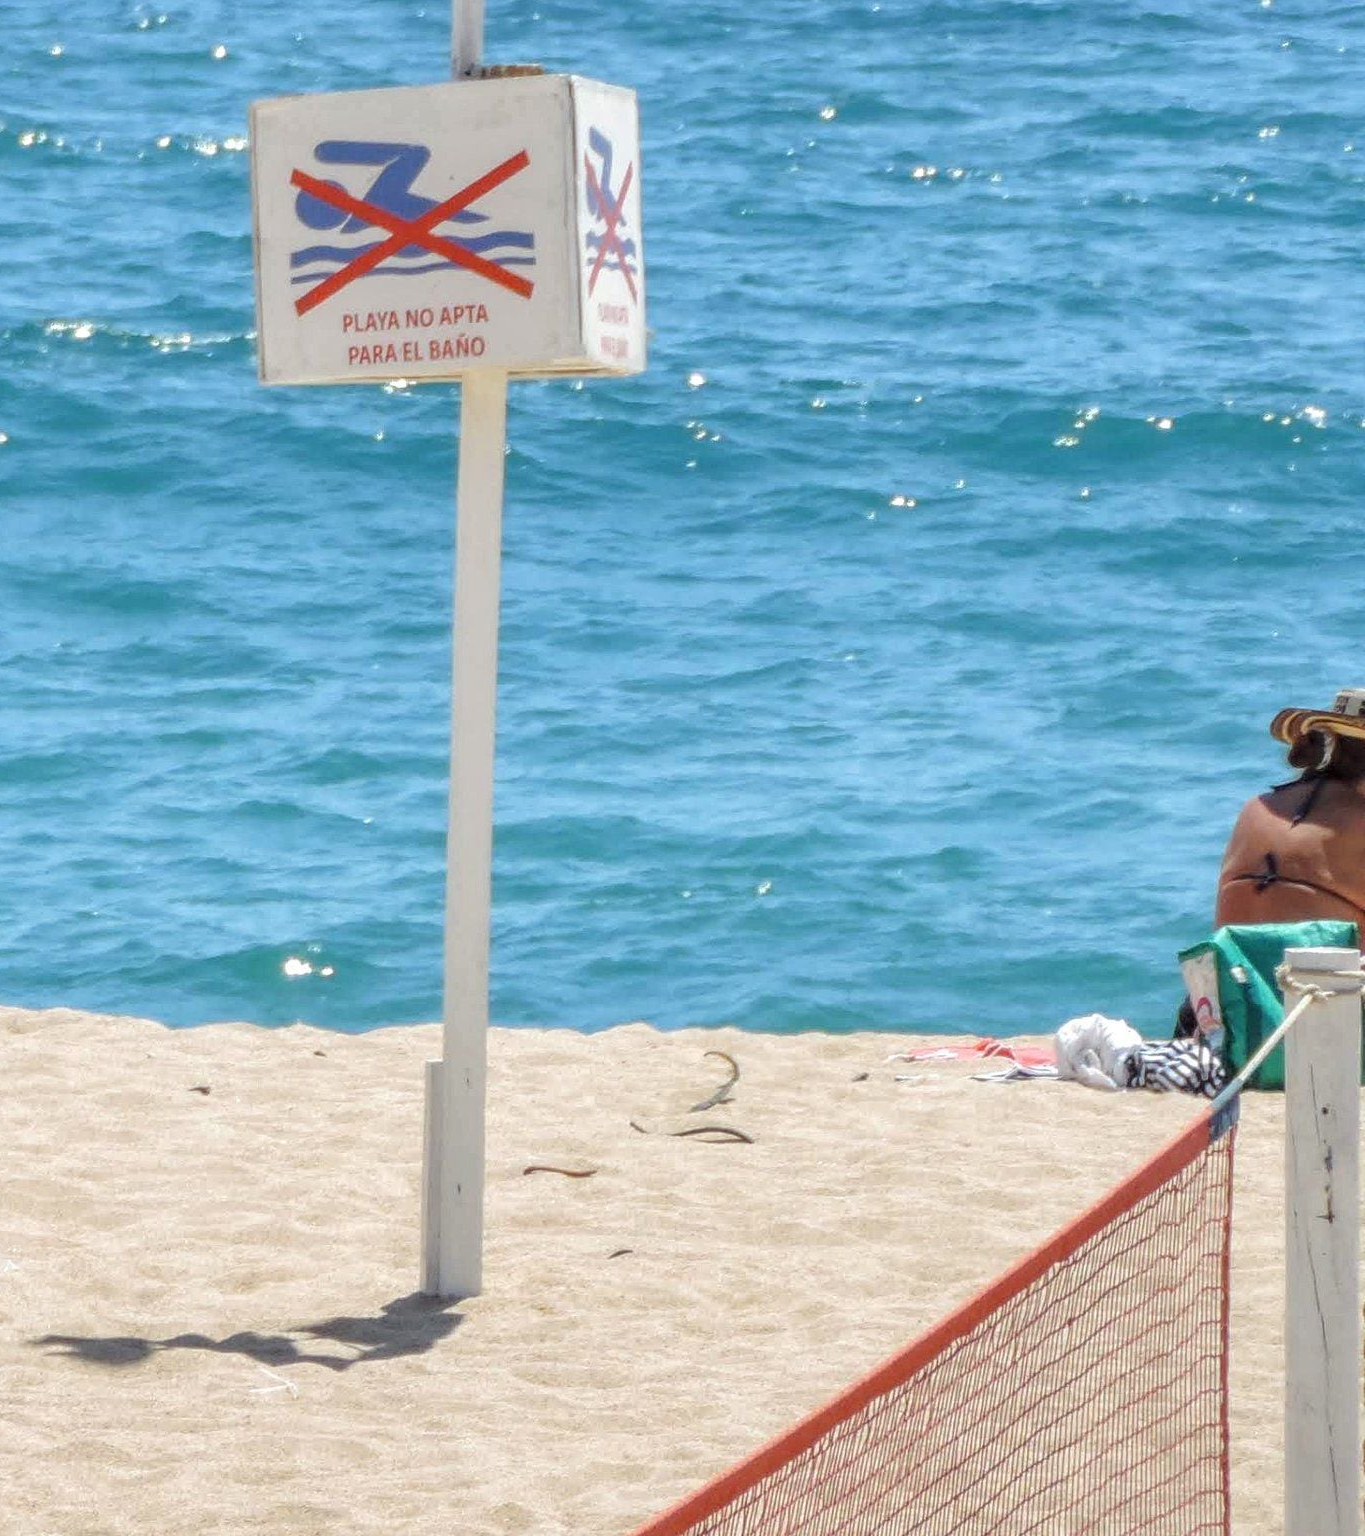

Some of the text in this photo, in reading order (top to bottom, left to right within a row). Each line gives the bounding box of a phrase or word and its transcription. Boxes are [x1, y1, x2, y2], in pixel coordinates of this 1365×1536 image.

[342, 304, 490, 333] PLAYA NO APTA
[348, 335, 487, 365] PARA EL BAÑO
